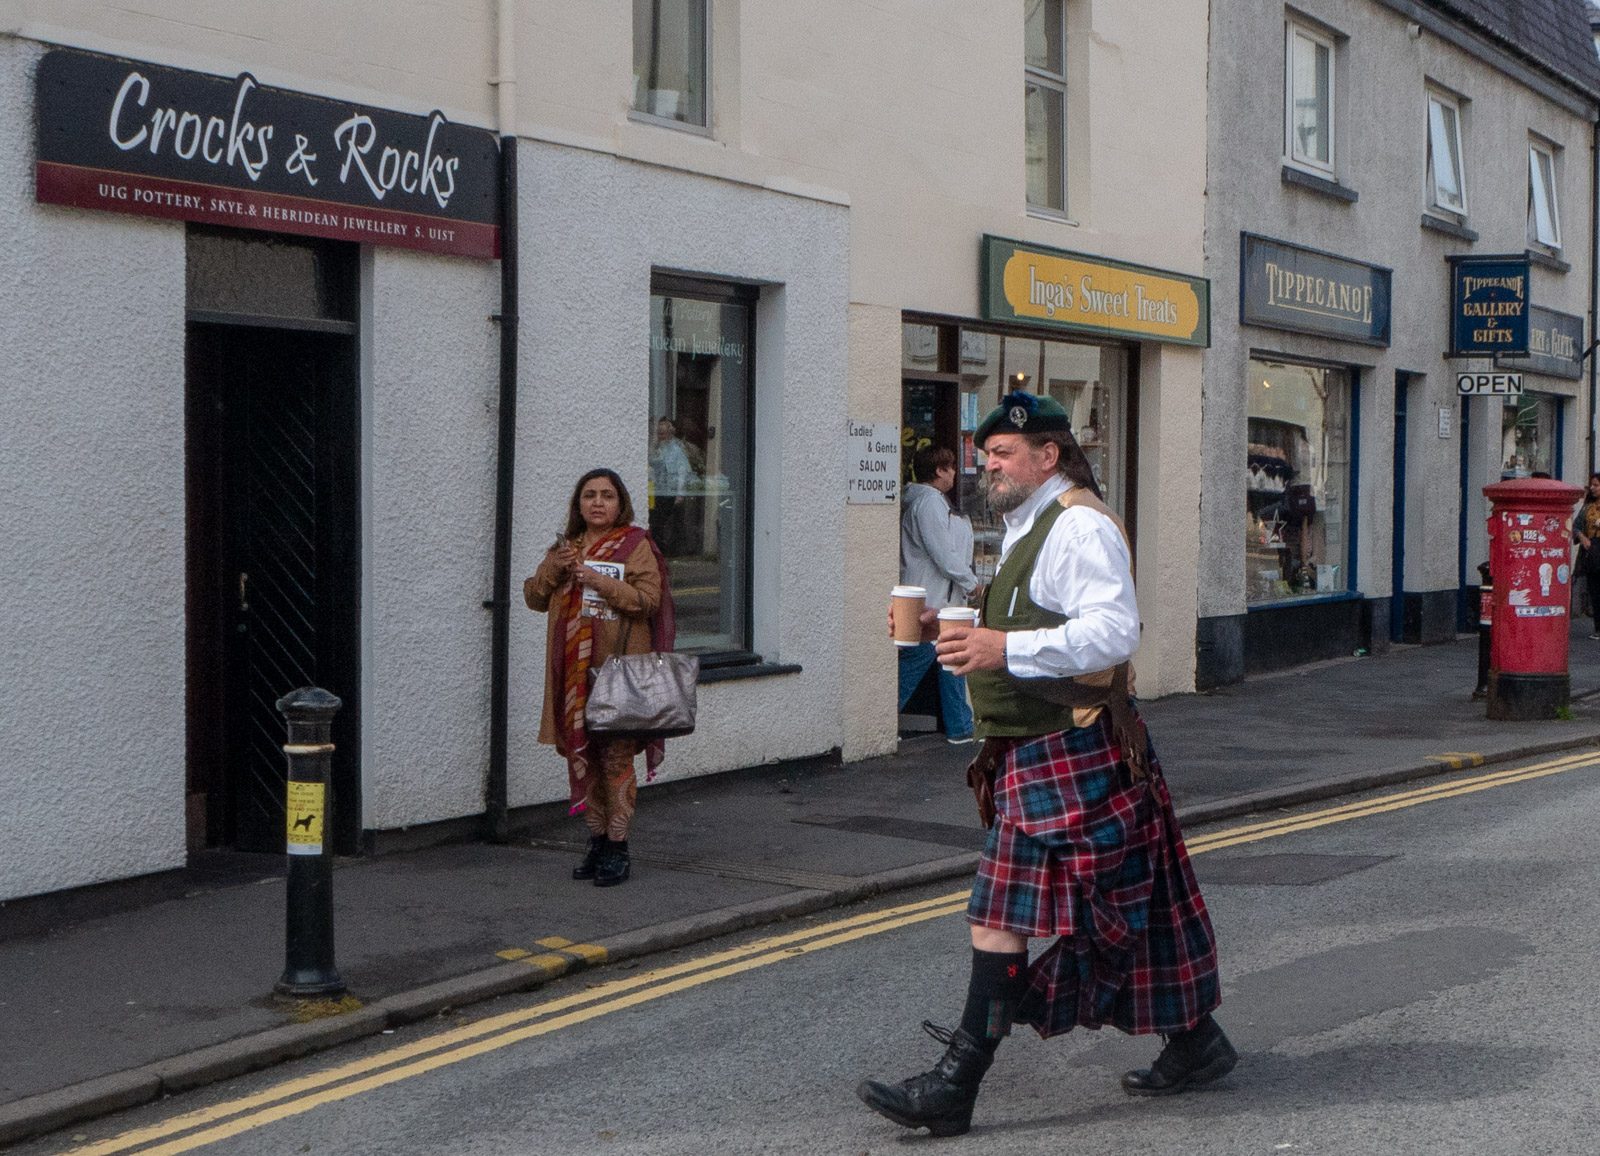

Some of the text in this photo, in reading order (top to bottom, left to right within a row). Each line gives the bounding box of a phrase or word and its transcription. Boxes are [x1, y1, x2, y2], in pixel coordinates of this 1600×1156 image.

[109, 72, 460, 209] Crocks & Rocks
[98, 183, 128, 200] UIG
[134, 188, 205, 212] POTTERY,
[263, 204, 339, 228] HEBRIDEAN
[343, 216, 408, 236] JEWELLERY
[415, 226, 425, 239] S.
[429, 227, 456, 243] UIST
[1029, 265, 1178, 326] Inga's Sweet Treats
[1265, 262, 1373, 324] TIPPECANOE
[1463, 302, 1524, 317] GALLERY
[1487, 317, 1499, 329] &
[1473, 329, 1513, 343] GIFTS
[1459, 375, 1522, 393] OPEN
[867, 441, 897, 454] & Gents
[860, 460, 887, 472] SALON
[858, 479, 883, 491] FLOOR
[885, 480, 897, 491] UP
